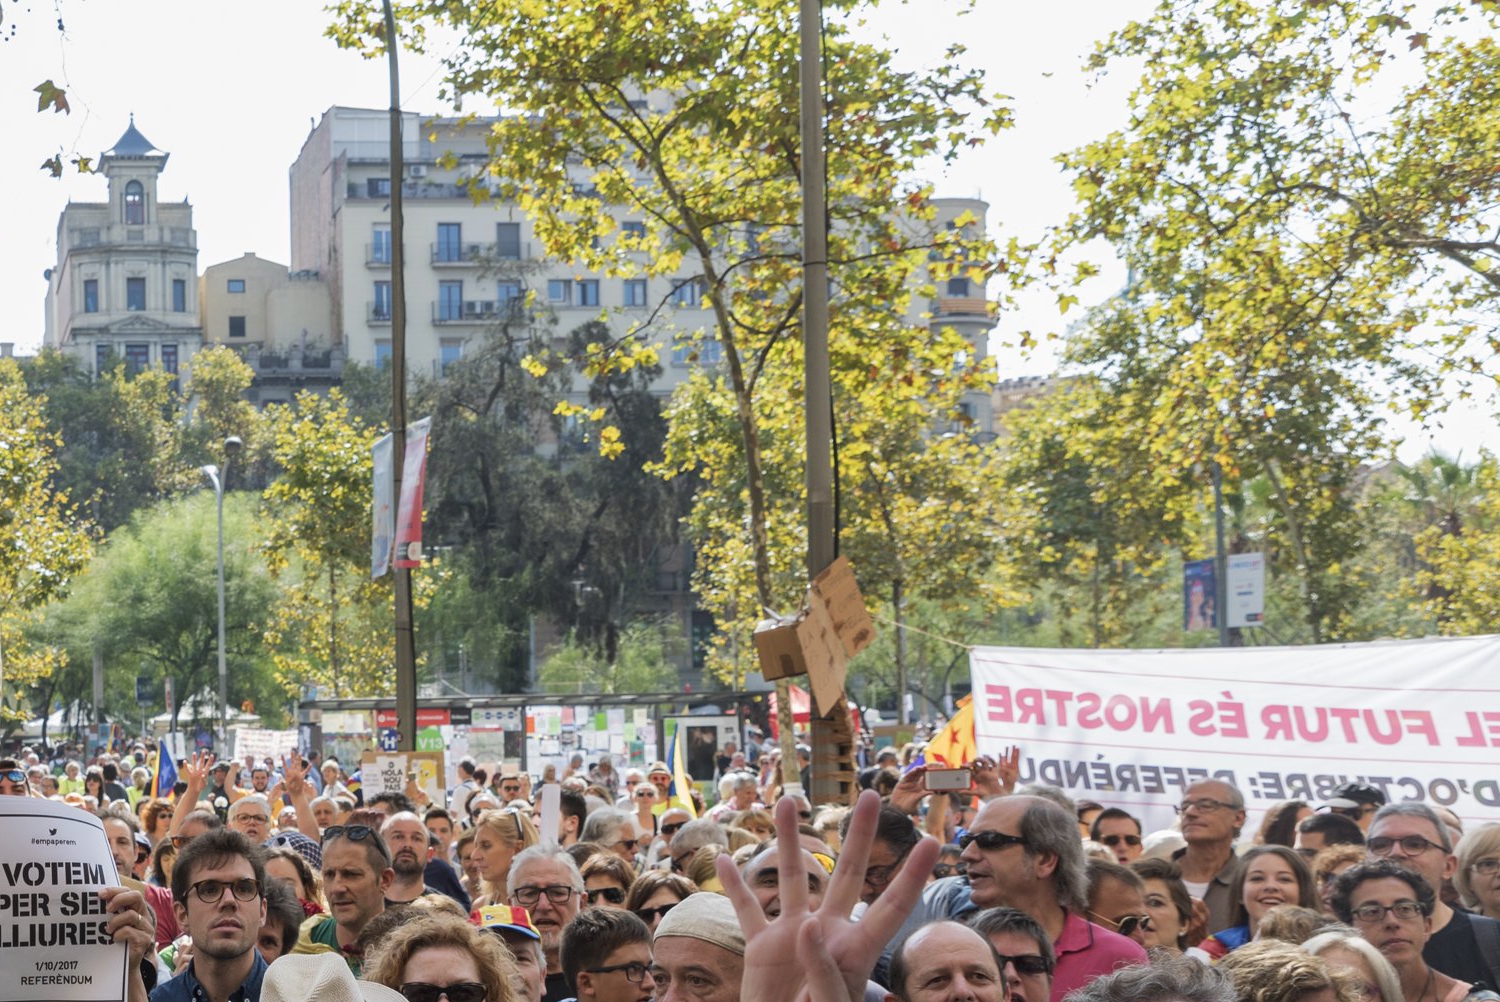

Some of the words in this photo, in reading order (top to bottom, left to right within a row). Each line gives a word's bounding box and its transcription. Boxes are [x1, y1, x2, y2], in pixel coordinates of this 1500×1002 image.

[418, 737, 443, 749] V13
[31, 837, 77, 846] #empaperem
[2, 861, 106, 887] VOTEM
[35, 960, 79, 972] 1/10/2017
[20, 973, 93, 986] REFERÈNDUM
